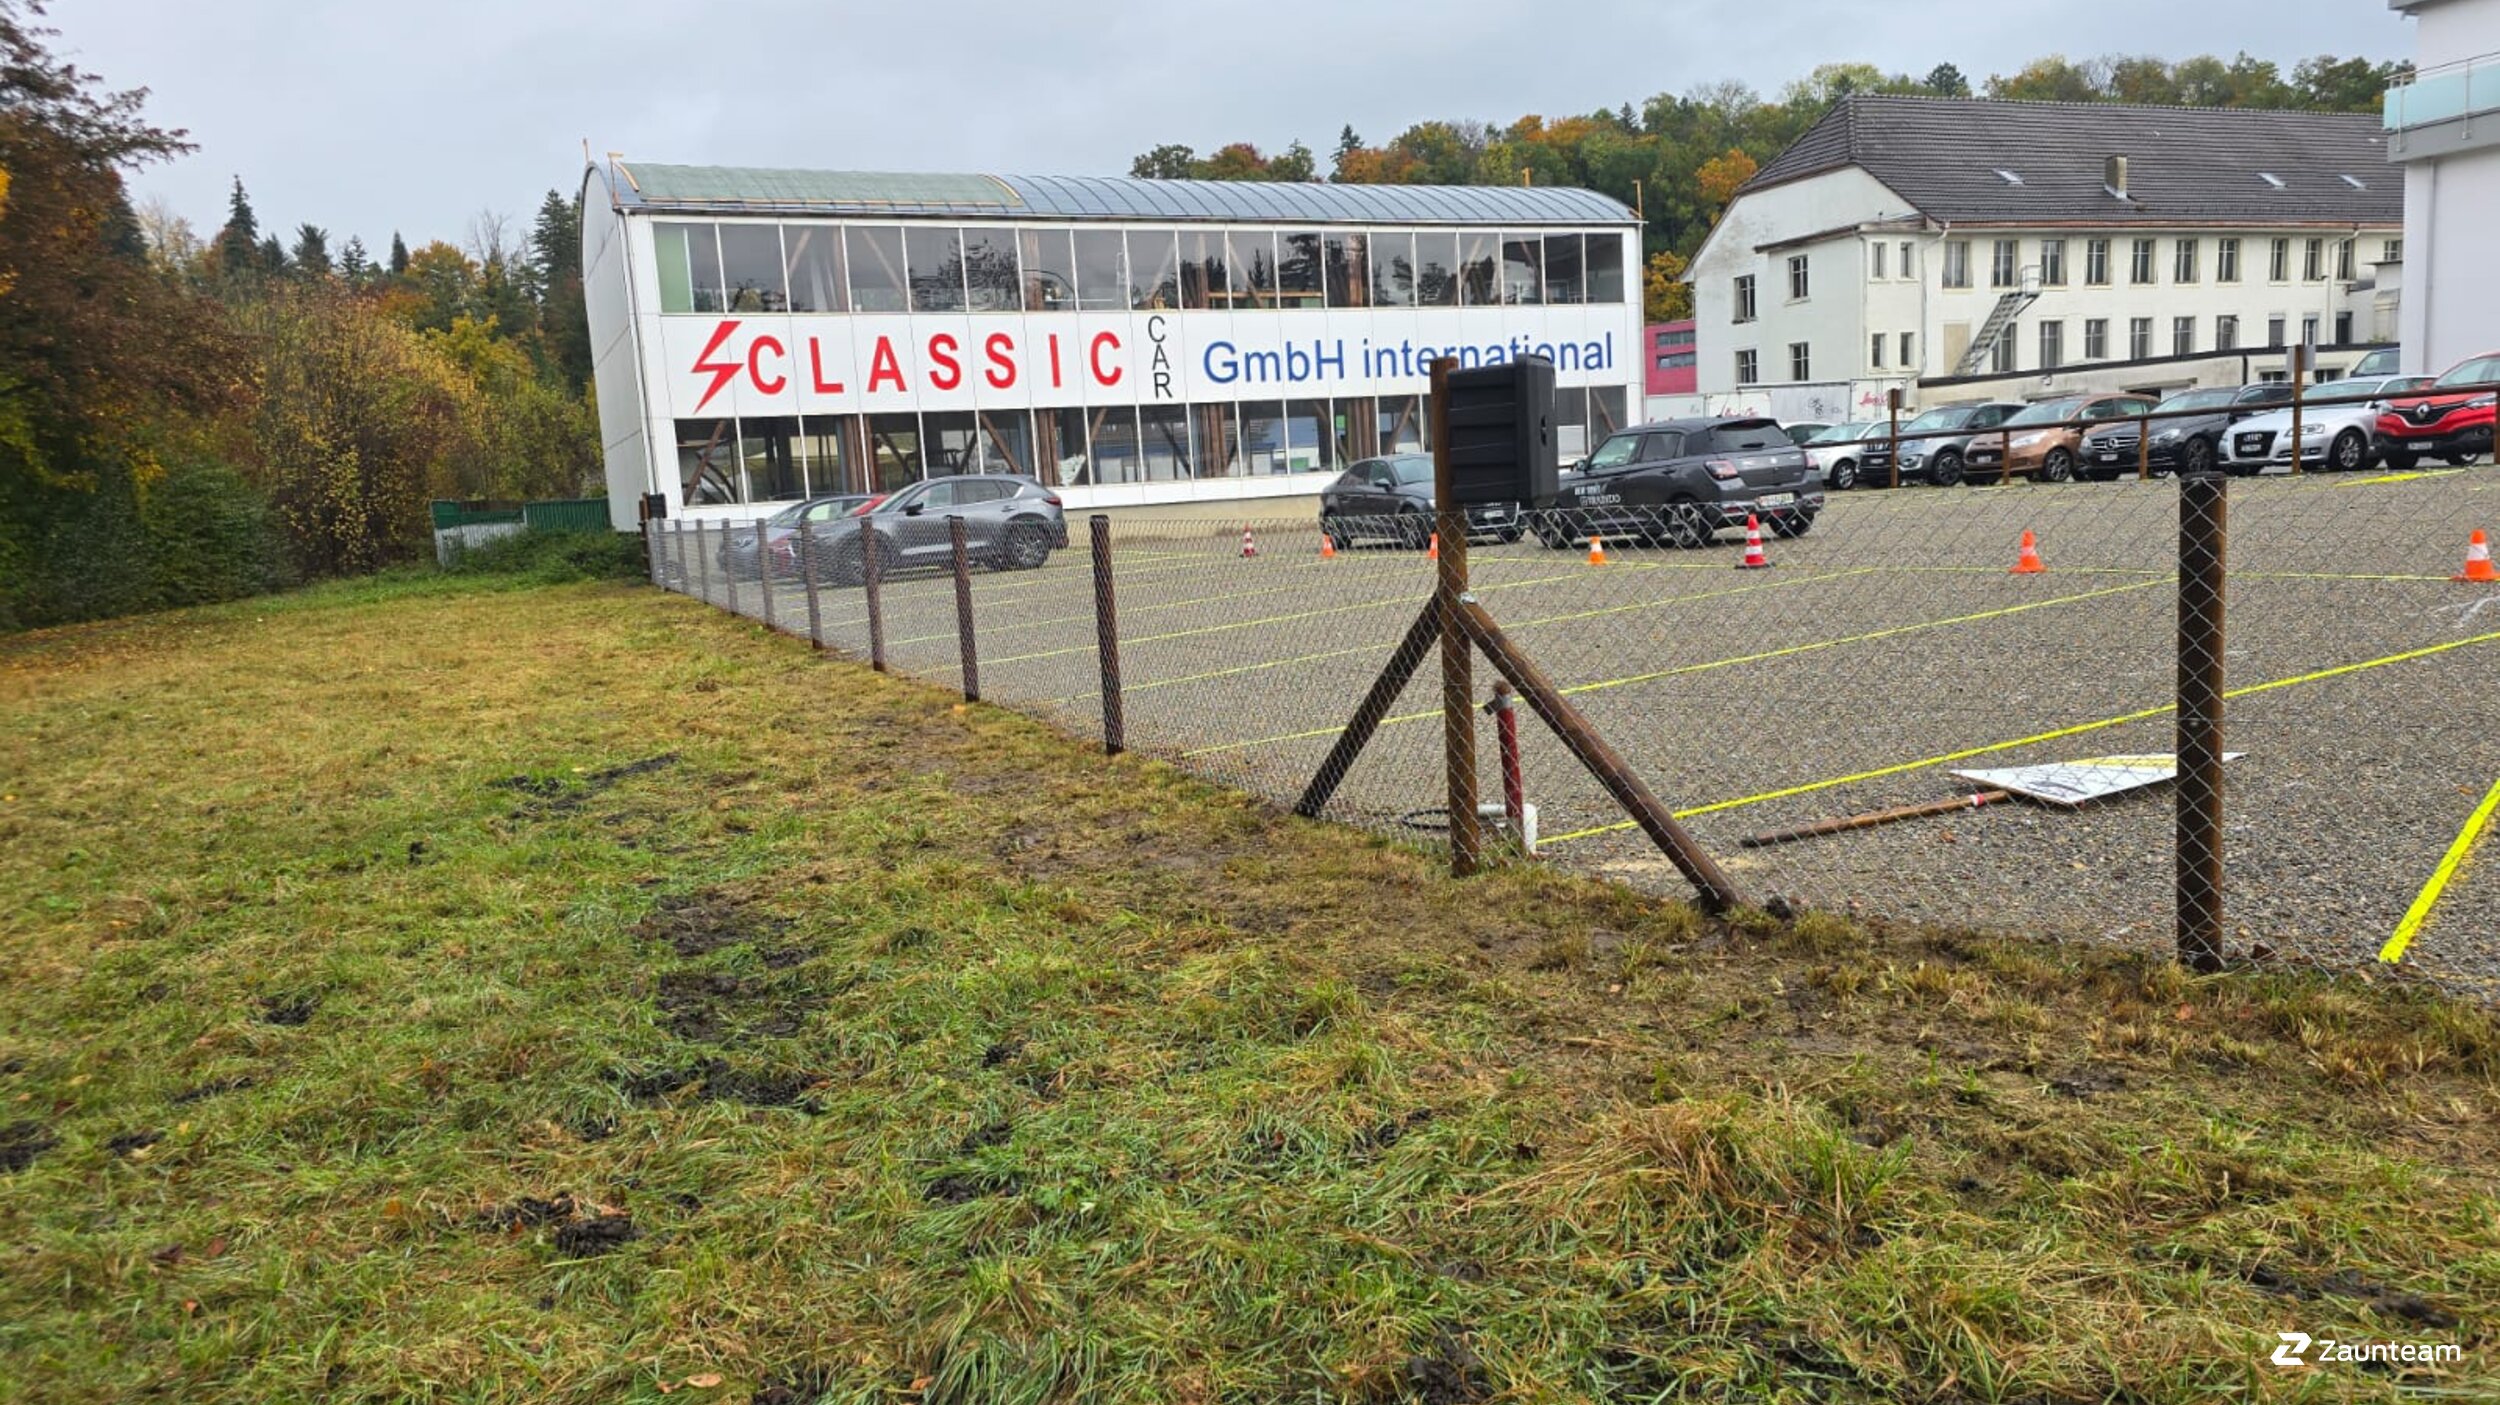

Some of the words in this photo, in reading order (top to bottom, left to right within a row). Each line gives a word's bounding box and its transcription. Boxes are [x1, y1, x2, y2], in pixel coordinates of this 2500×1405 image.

[747, 331, 1123, 396] CLASSIC
[1147, 315, 1173, 399] CAR
[1203, 339, 1345, 384] GmbH
